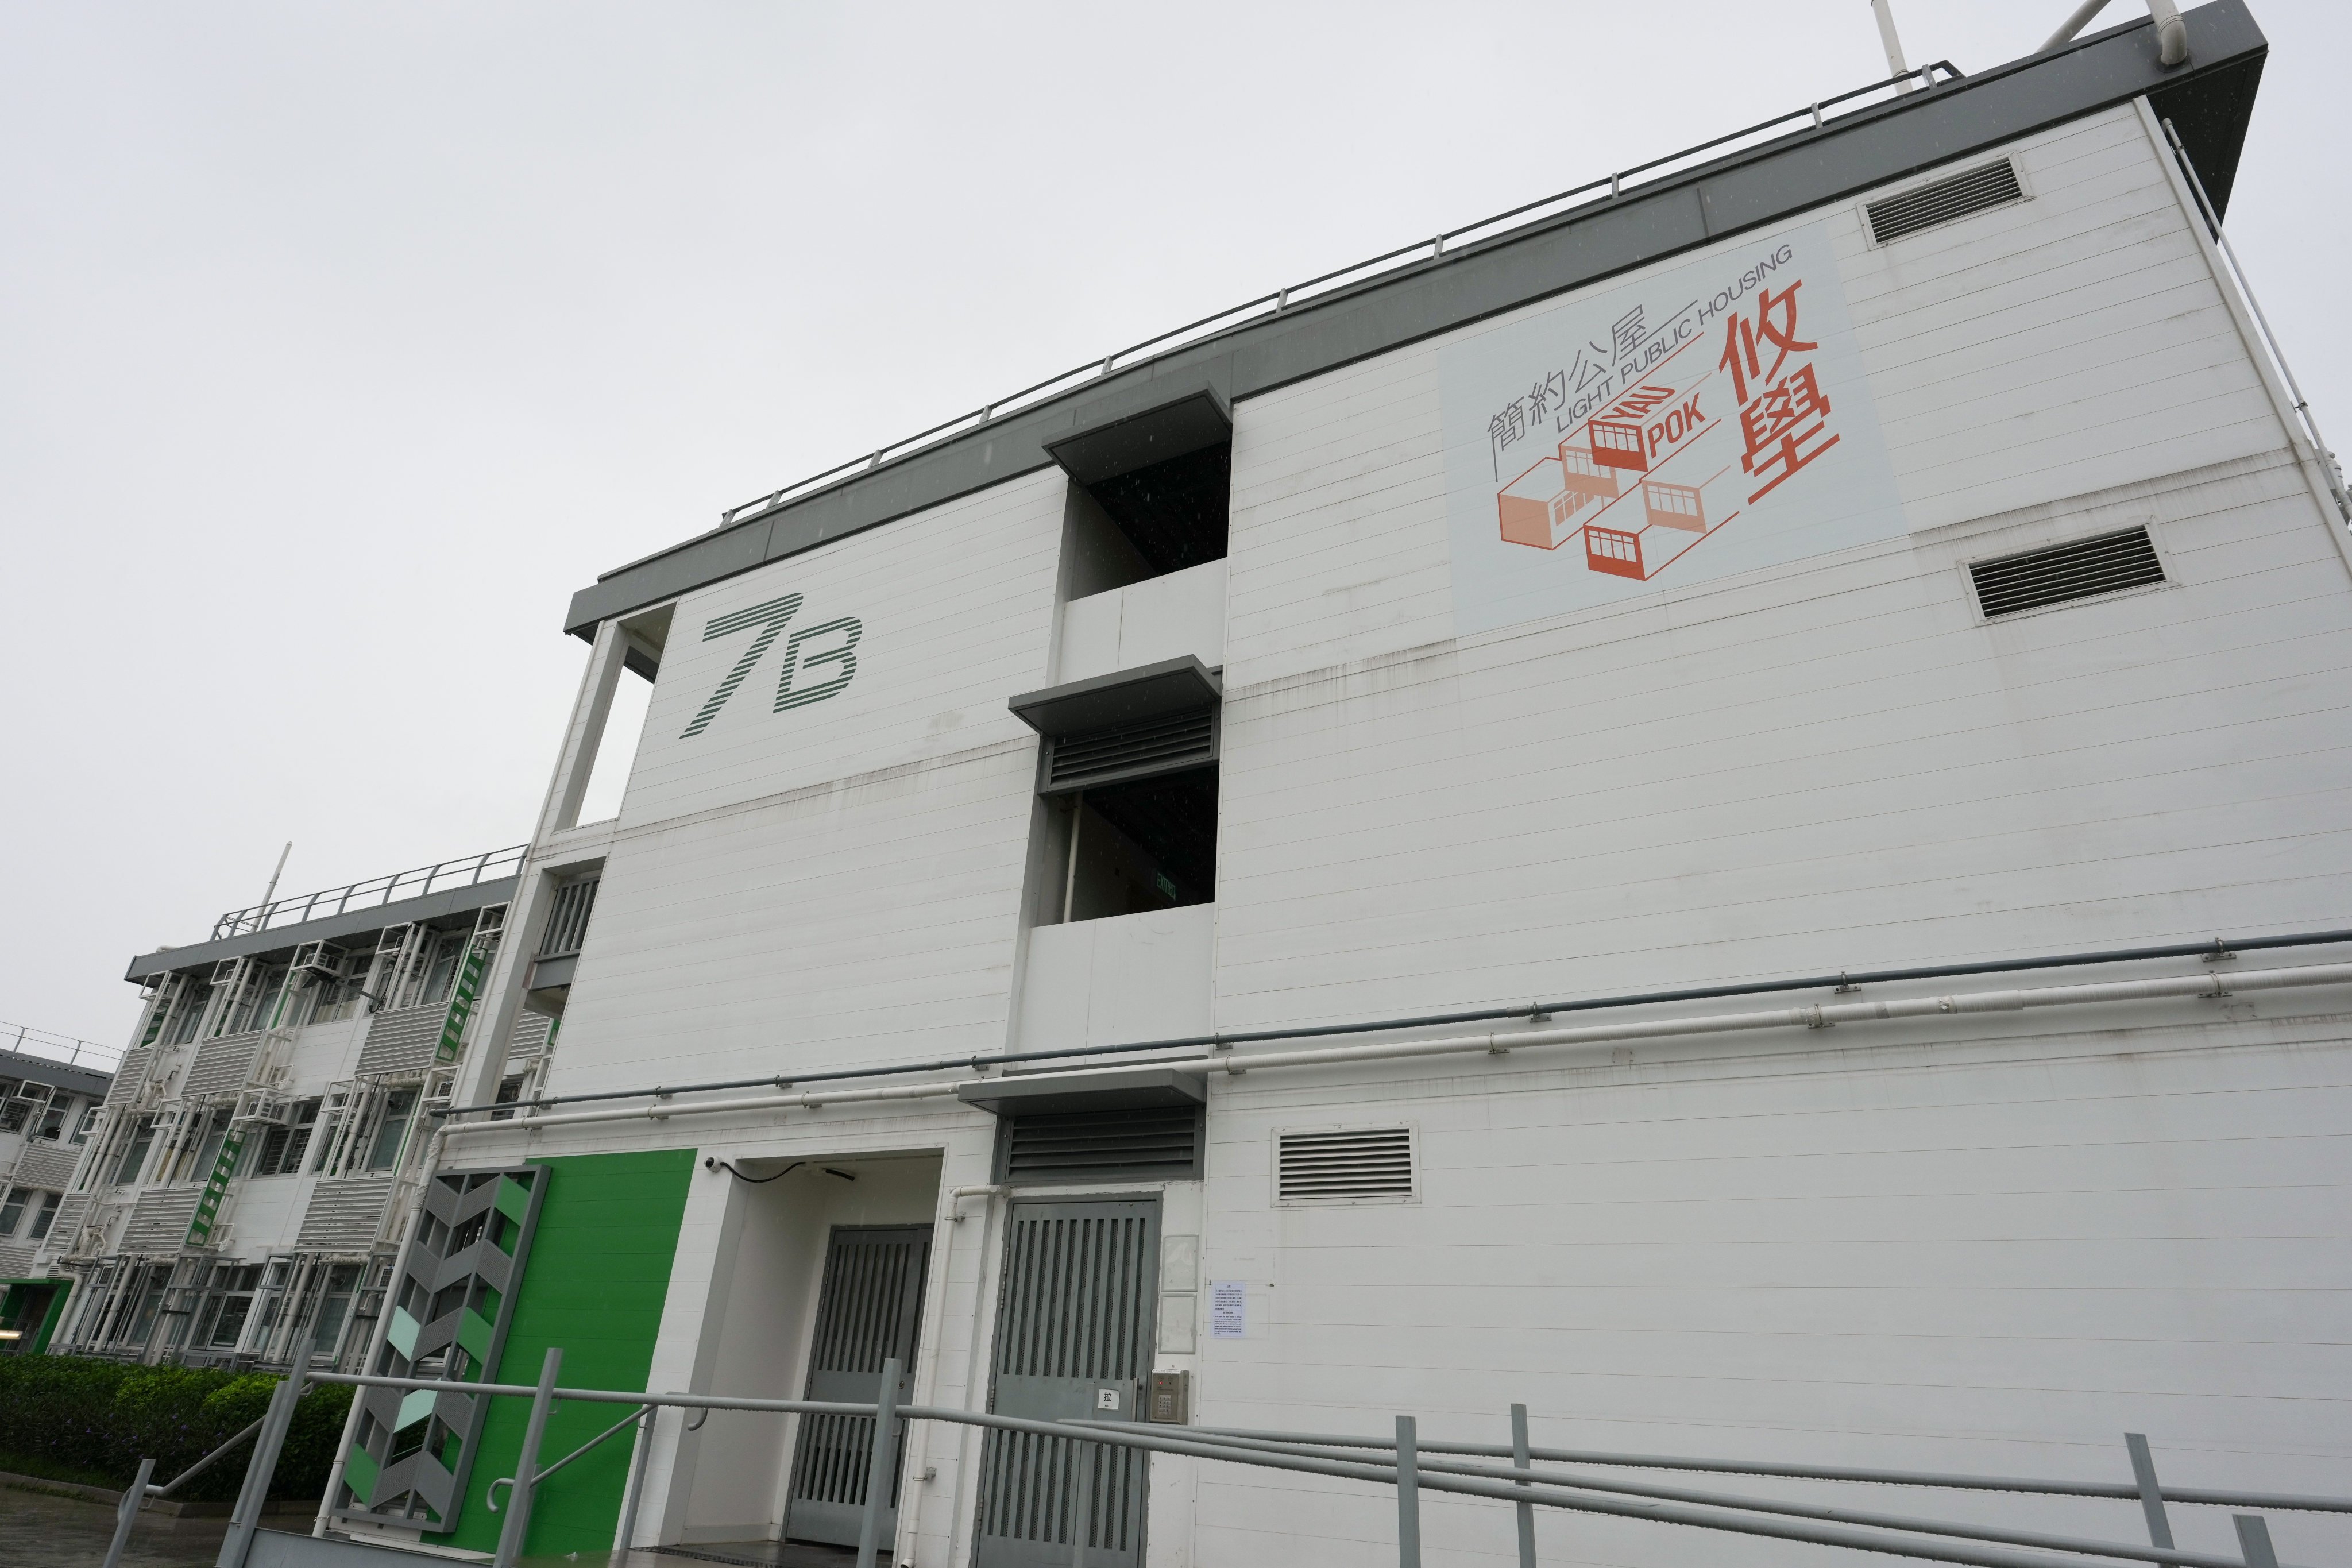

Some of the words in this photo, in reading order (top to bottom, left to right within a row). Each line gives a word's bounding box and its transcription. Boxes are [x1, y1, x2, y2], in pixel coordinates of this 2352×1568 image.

[1487, 304, 1647, 451] 簡約公屋
[1557, 375, 1614, 434] LIGHT
[1620, 319, 1692, 385] PUBLIC
[1698, 244, 1793, 326] HOUSING
[1718, 279, 1840, 505] 攸壆
[1599, 385, 1675, 419] YAU
[1647, 392, 1706, 459] POK
[678, 592, 863, 740] 7B
[1157, 872, 1169, 893] EXIT
[1104, 1392, 1112, 1401] 拉
